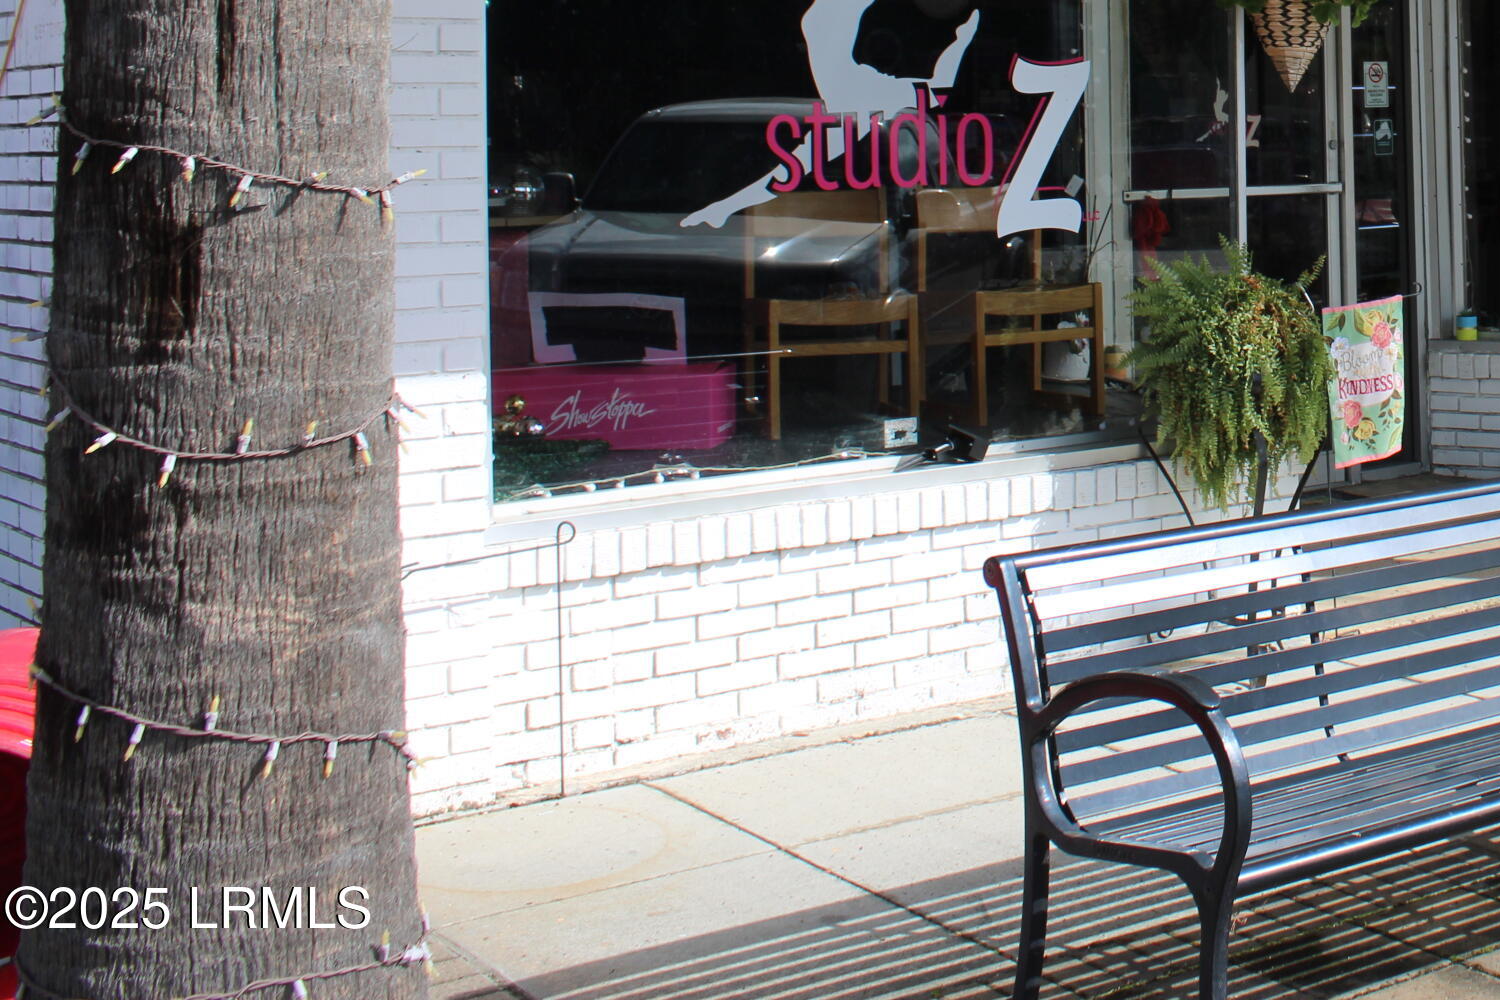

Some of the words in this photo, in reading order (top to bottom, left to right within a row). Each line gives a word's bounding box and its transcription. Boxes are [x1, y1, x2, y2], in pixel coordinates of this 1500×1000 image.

[766, 89, 994, 192] studio
[995, 52, 1091, 238] Z
[1340, 349, 1384, 371] Bloom
[1338, 374, 1394, 399] KINDNESS
